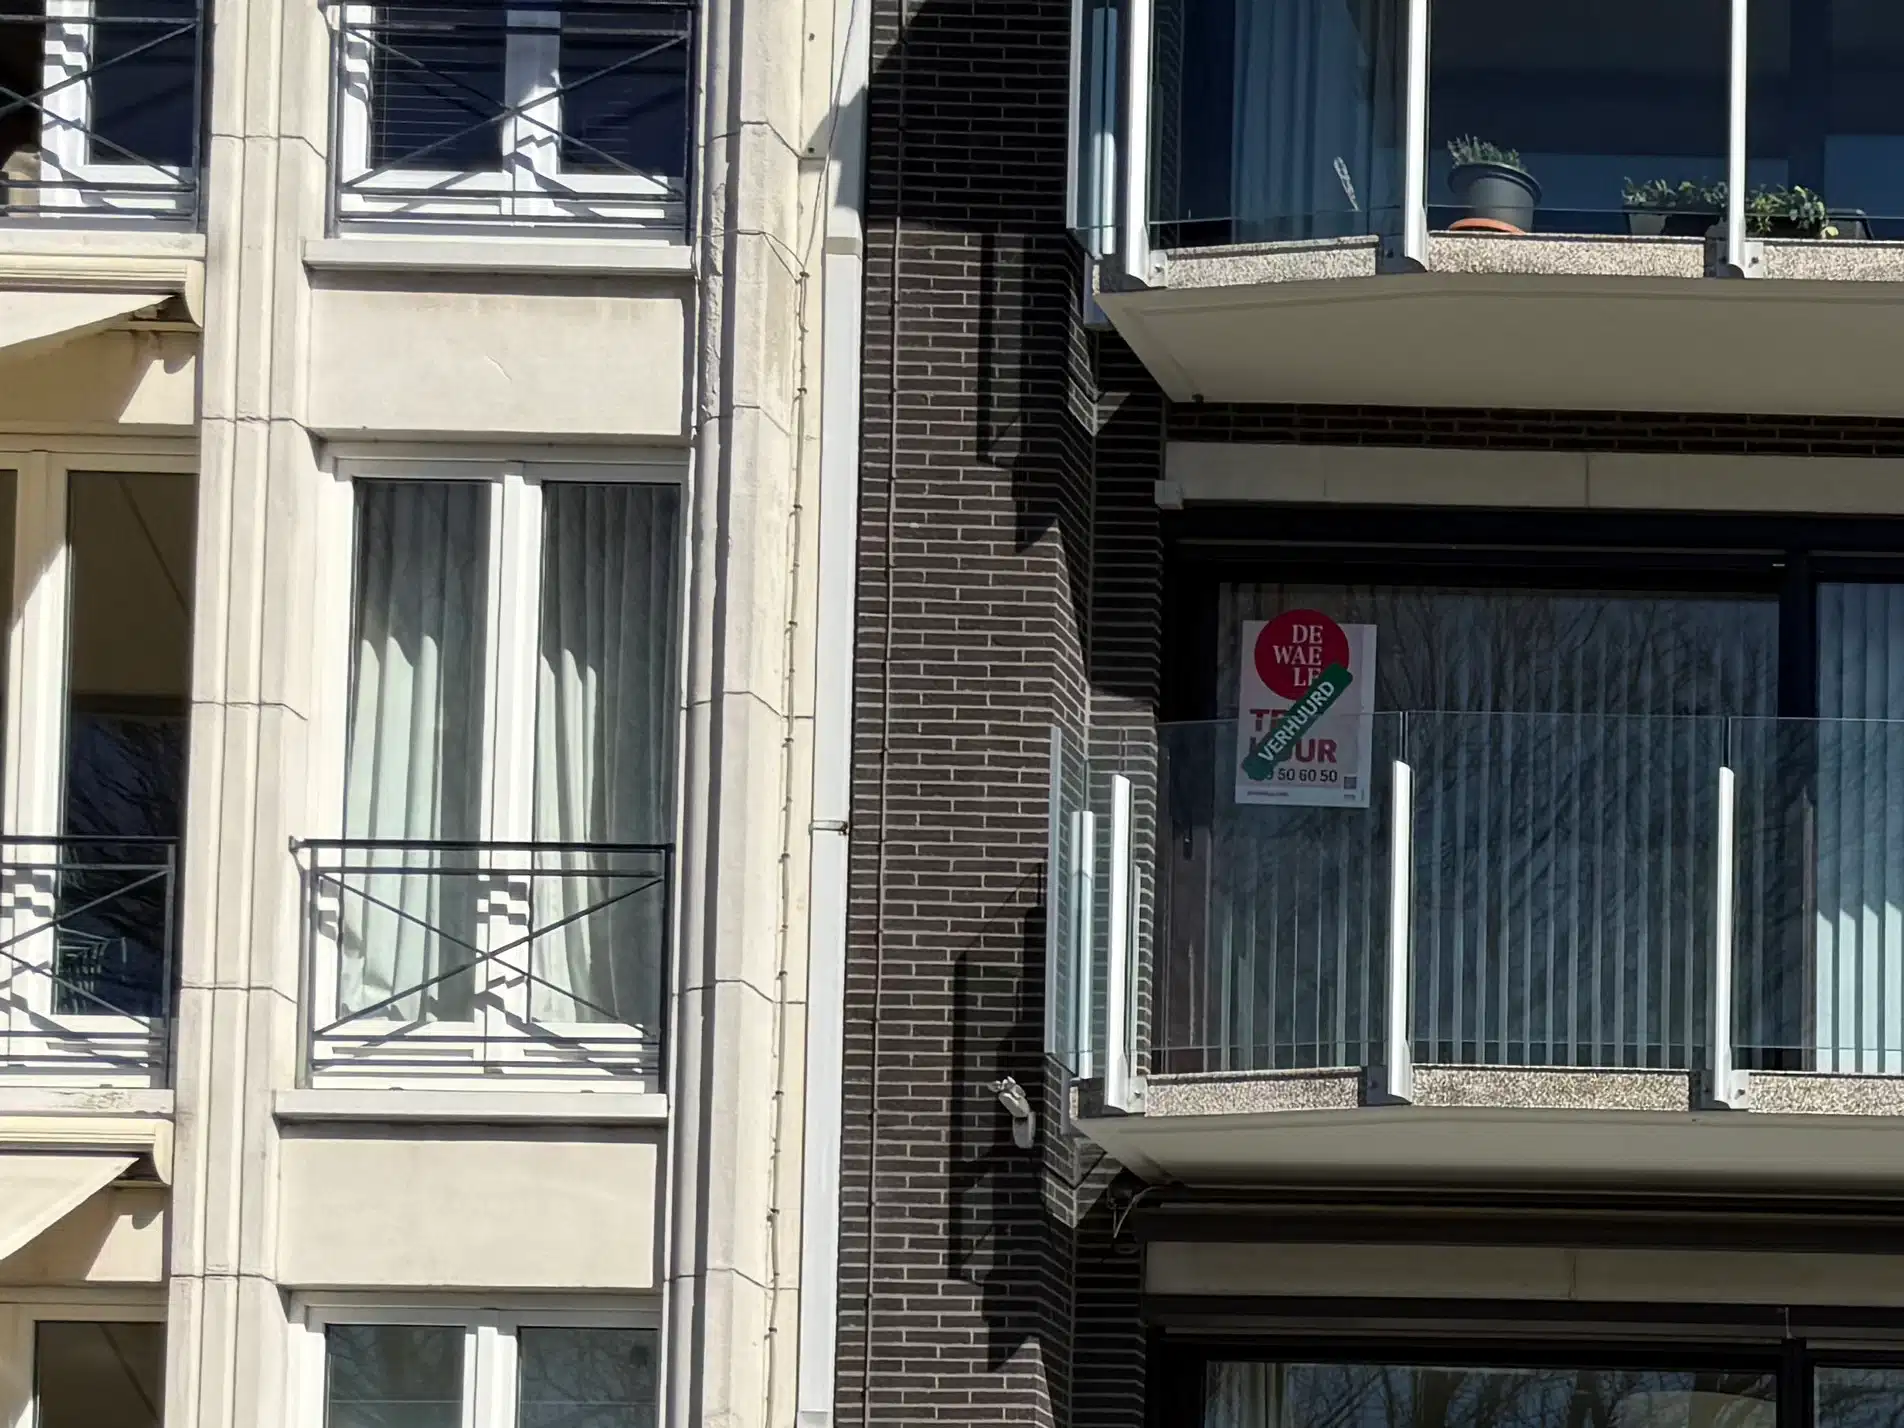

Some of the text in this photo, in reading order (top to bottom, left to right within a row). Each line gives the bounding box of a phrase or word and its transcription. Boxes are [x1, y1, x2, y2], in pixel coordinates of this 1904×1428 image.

[1292, 624, 1324, 644] DE
[1273, 645, 1322, 665] WAE
[1257, 680, 1336, 762] VERHUURD
